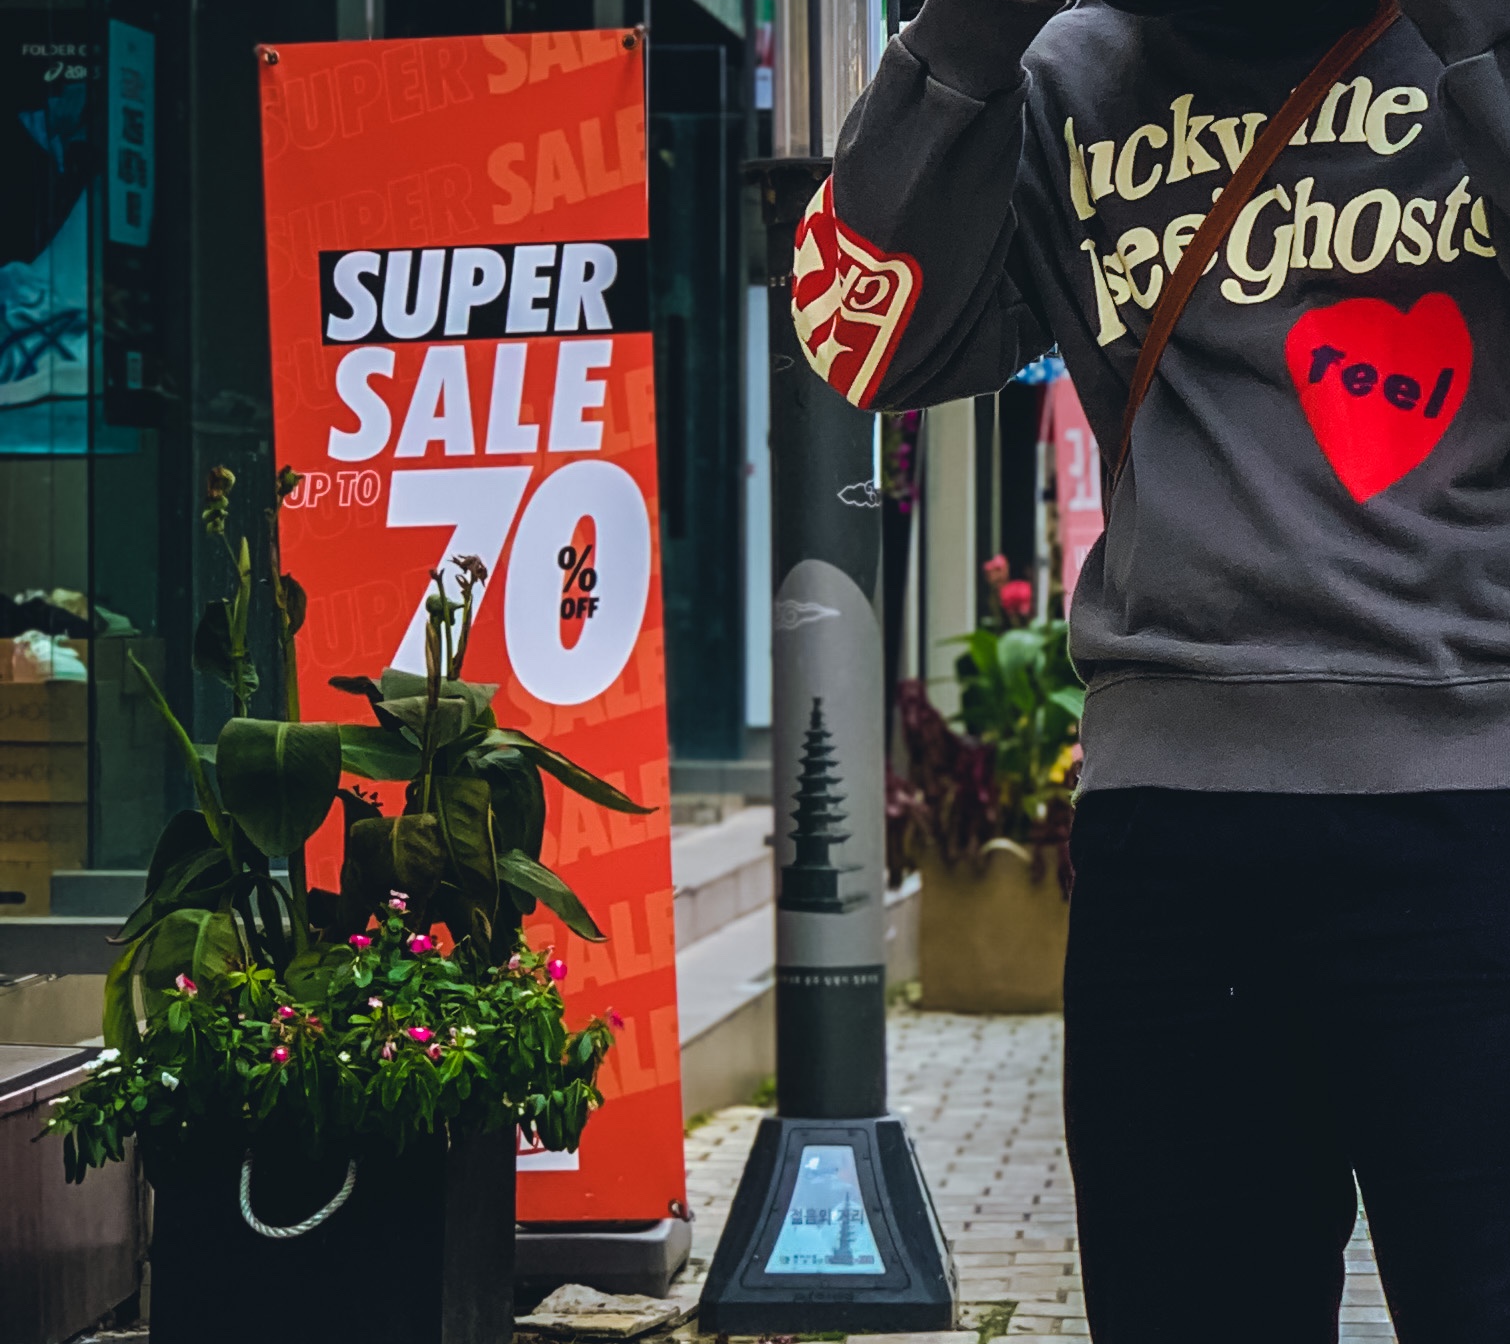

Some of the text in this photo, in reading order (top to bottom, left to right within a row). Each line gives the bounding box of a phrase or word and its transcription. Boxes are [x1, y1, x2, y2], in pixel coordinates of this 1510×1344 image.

[326, 242, 618, 343] SUPER
[327, 339, 614, 462] SALE
[281, 469, 381, 510] UP TO
[386, 458, 652, 706] 70
[560, 596, 600, 620] OFF
